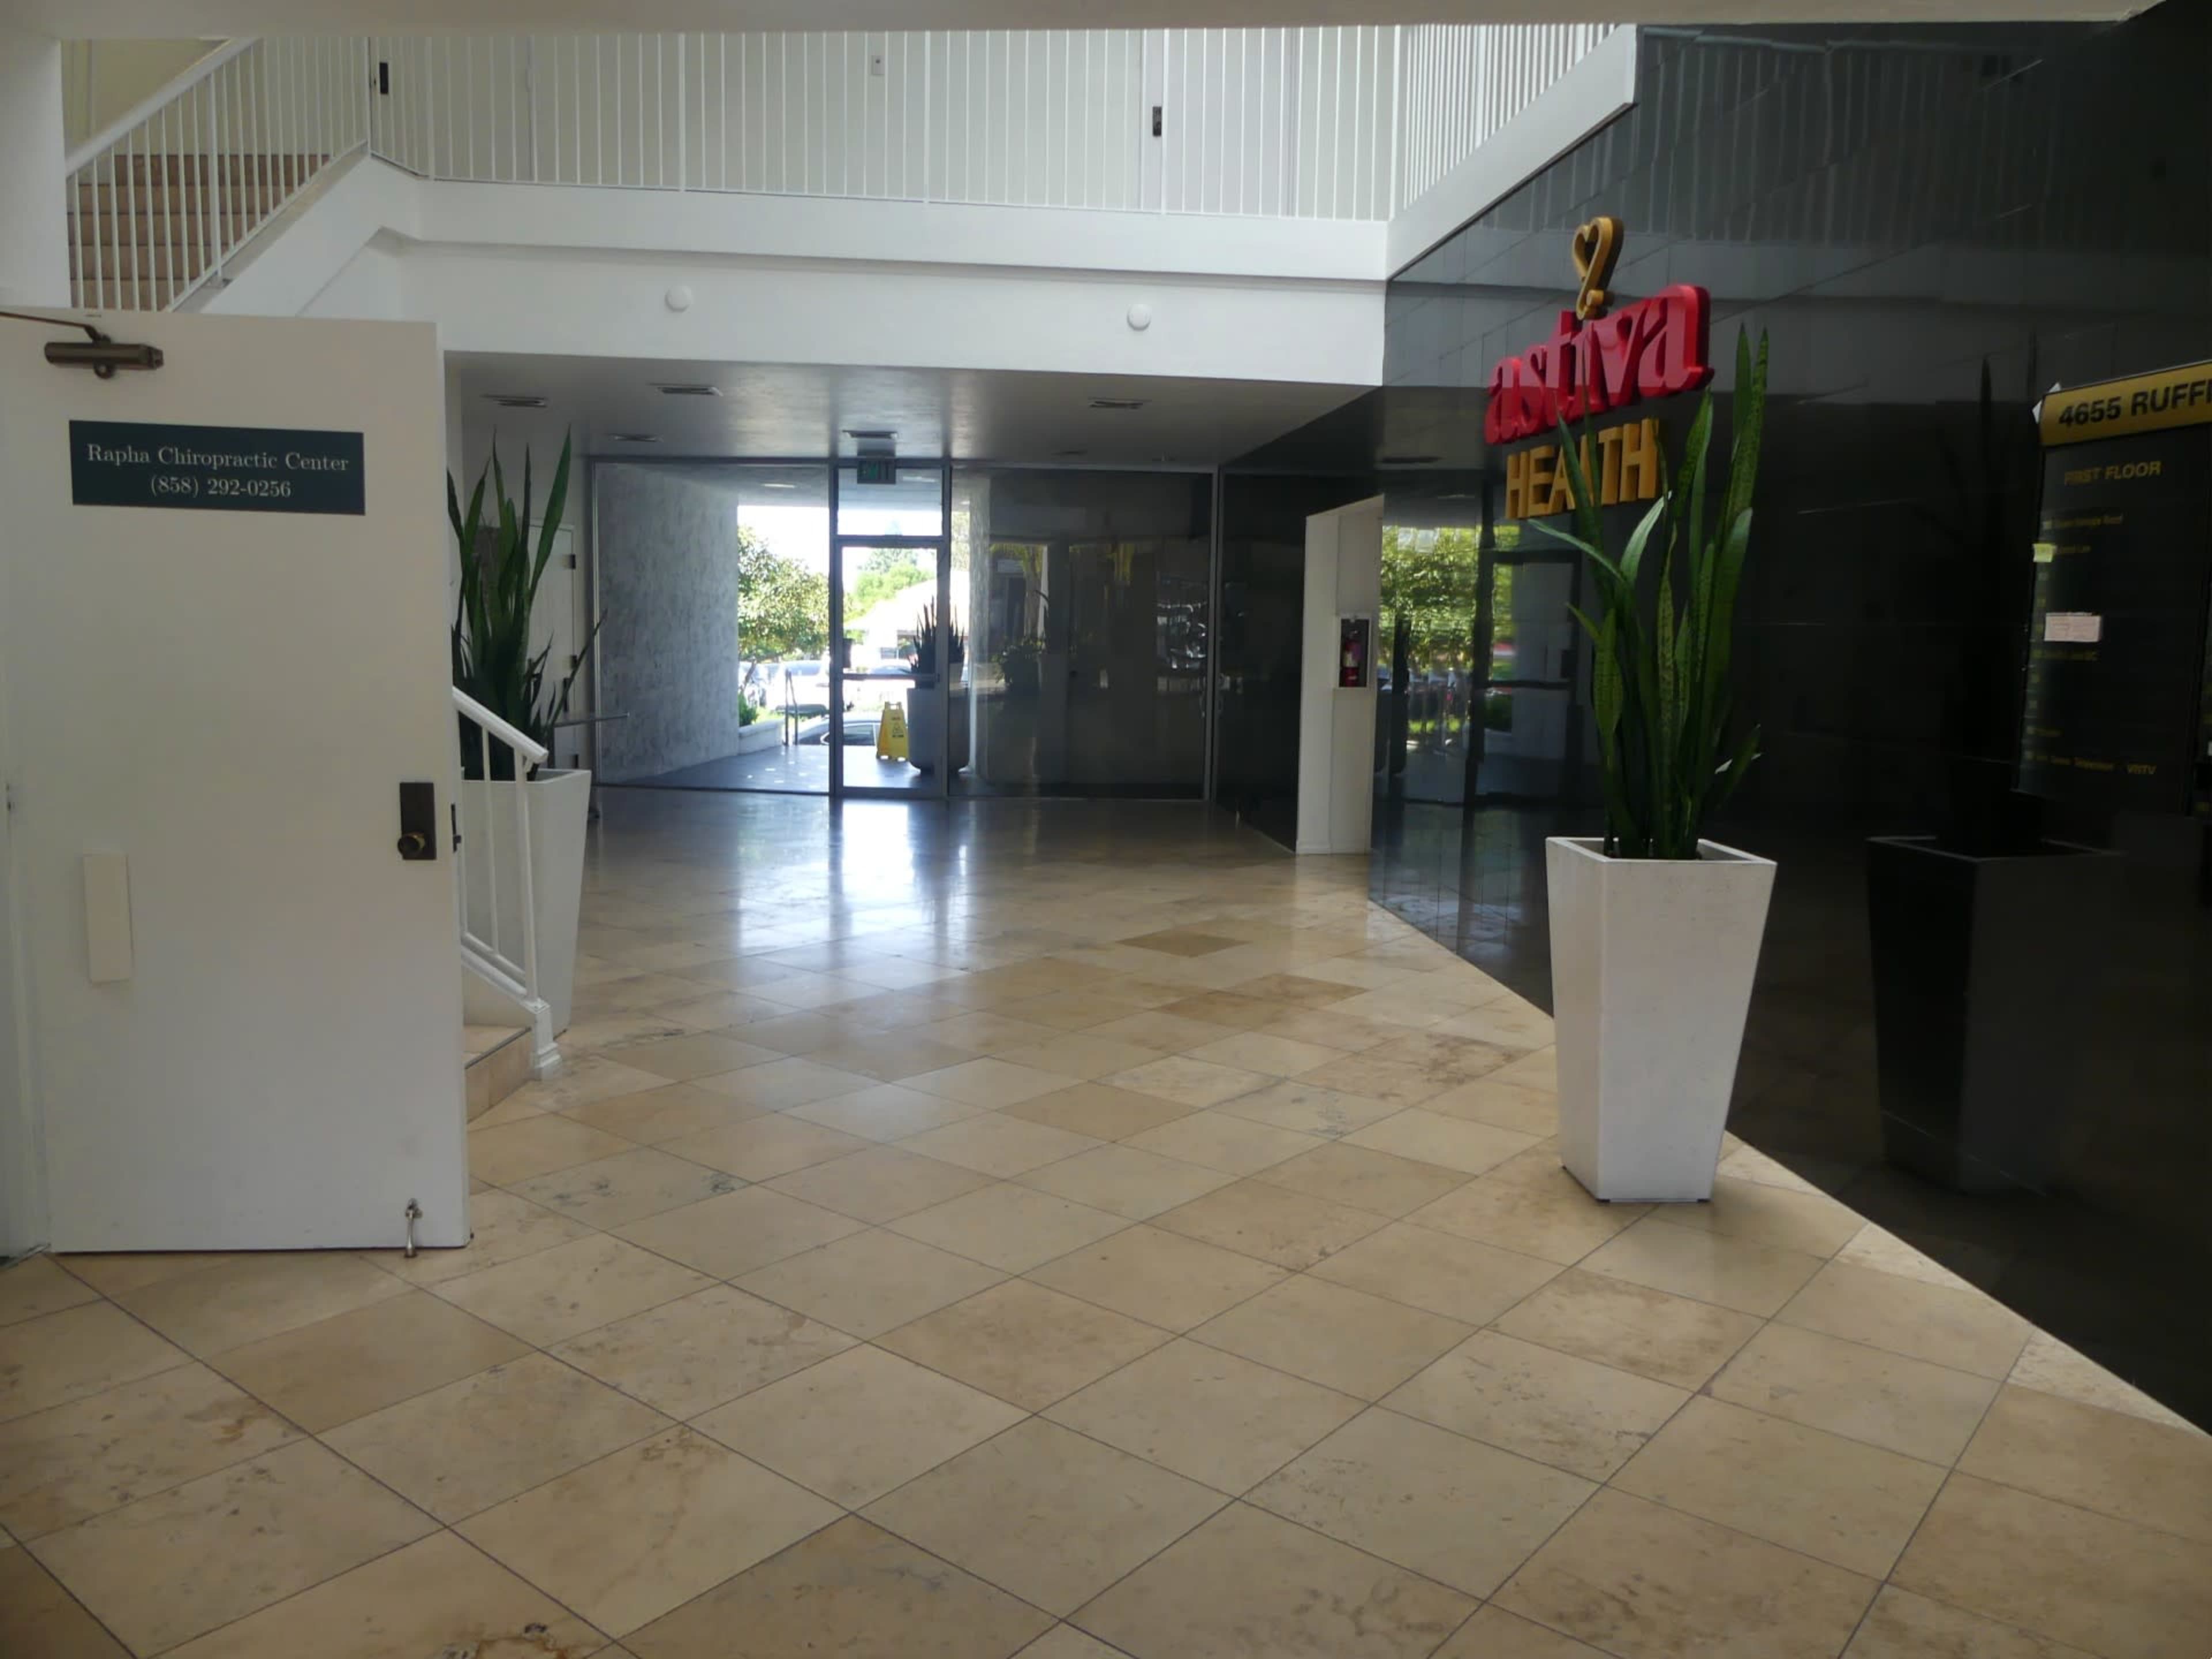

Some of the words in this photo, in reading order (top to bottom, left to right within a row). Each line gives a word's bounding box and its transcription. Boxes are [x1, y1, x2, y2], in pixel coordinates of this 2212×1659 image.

[1484, 284, 1713, 442] astiva
[2059, 397, 2122, 427] 4655
[87, 444, 150, 468] Rapha
[158, 445, 278, 469] Chiropractic
[285, 452, 349, 471] Center
[2104, 461, 2162, 479] FLOOR
[150, 477, 199, 498] (858)
[207, 478, 291, 497] 292-0256
